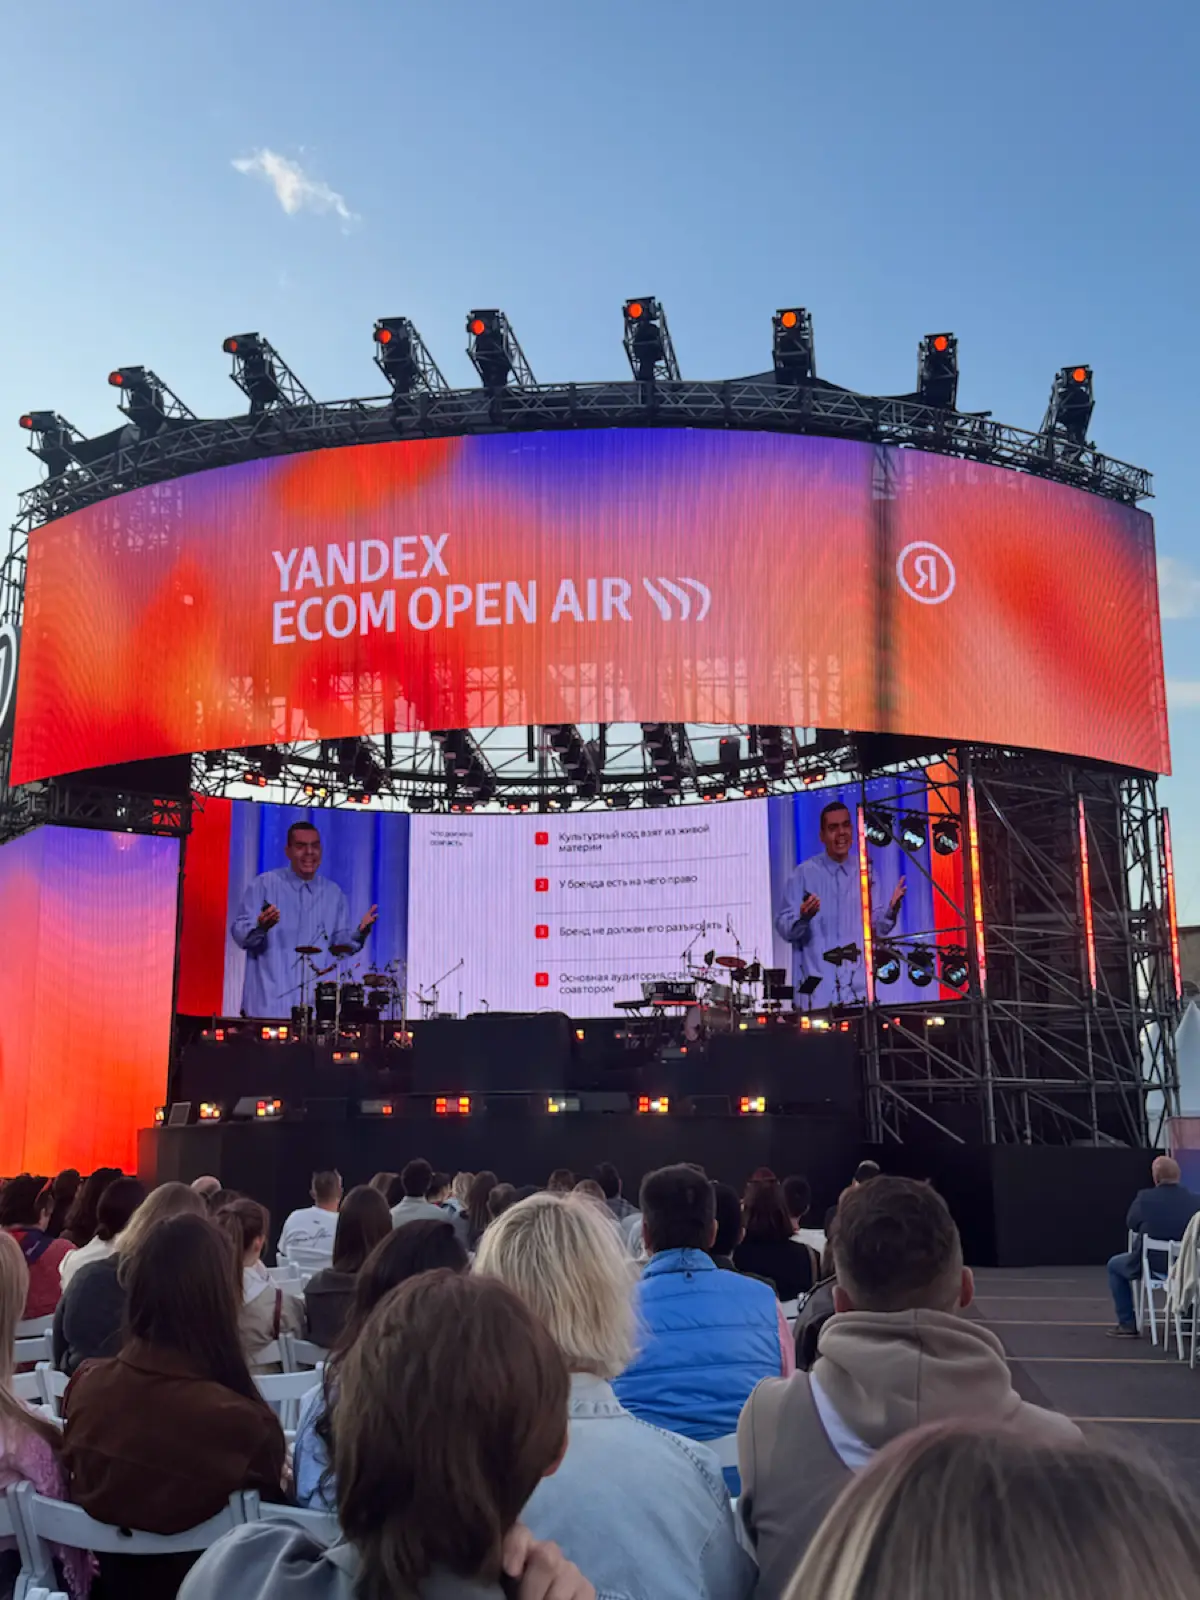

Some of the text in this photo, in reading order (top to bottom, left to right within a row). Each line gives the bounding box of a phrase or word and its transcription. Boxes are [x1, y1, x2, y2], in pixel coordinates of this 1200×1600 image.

[272, 533, 450, 592] YANDEX
[272, 577, 632, 645] ECOM OPEN AIR
[558, 823, 709, 843] Культурный код взят из живой
[558, 843, 602, 853] материи
[558, 875, 698, 889] У бренда есть на него право
[559, 926, 591, 937] Бренд
[592, 927, 604, 935] не
[606, 926, 645, 937] должен
[646, 925, 664, 934] его
[559, 972, 609, 982] Основная
[611, 971, 666, 983] аудитория
[558, 985, 614, 995] соавтором
